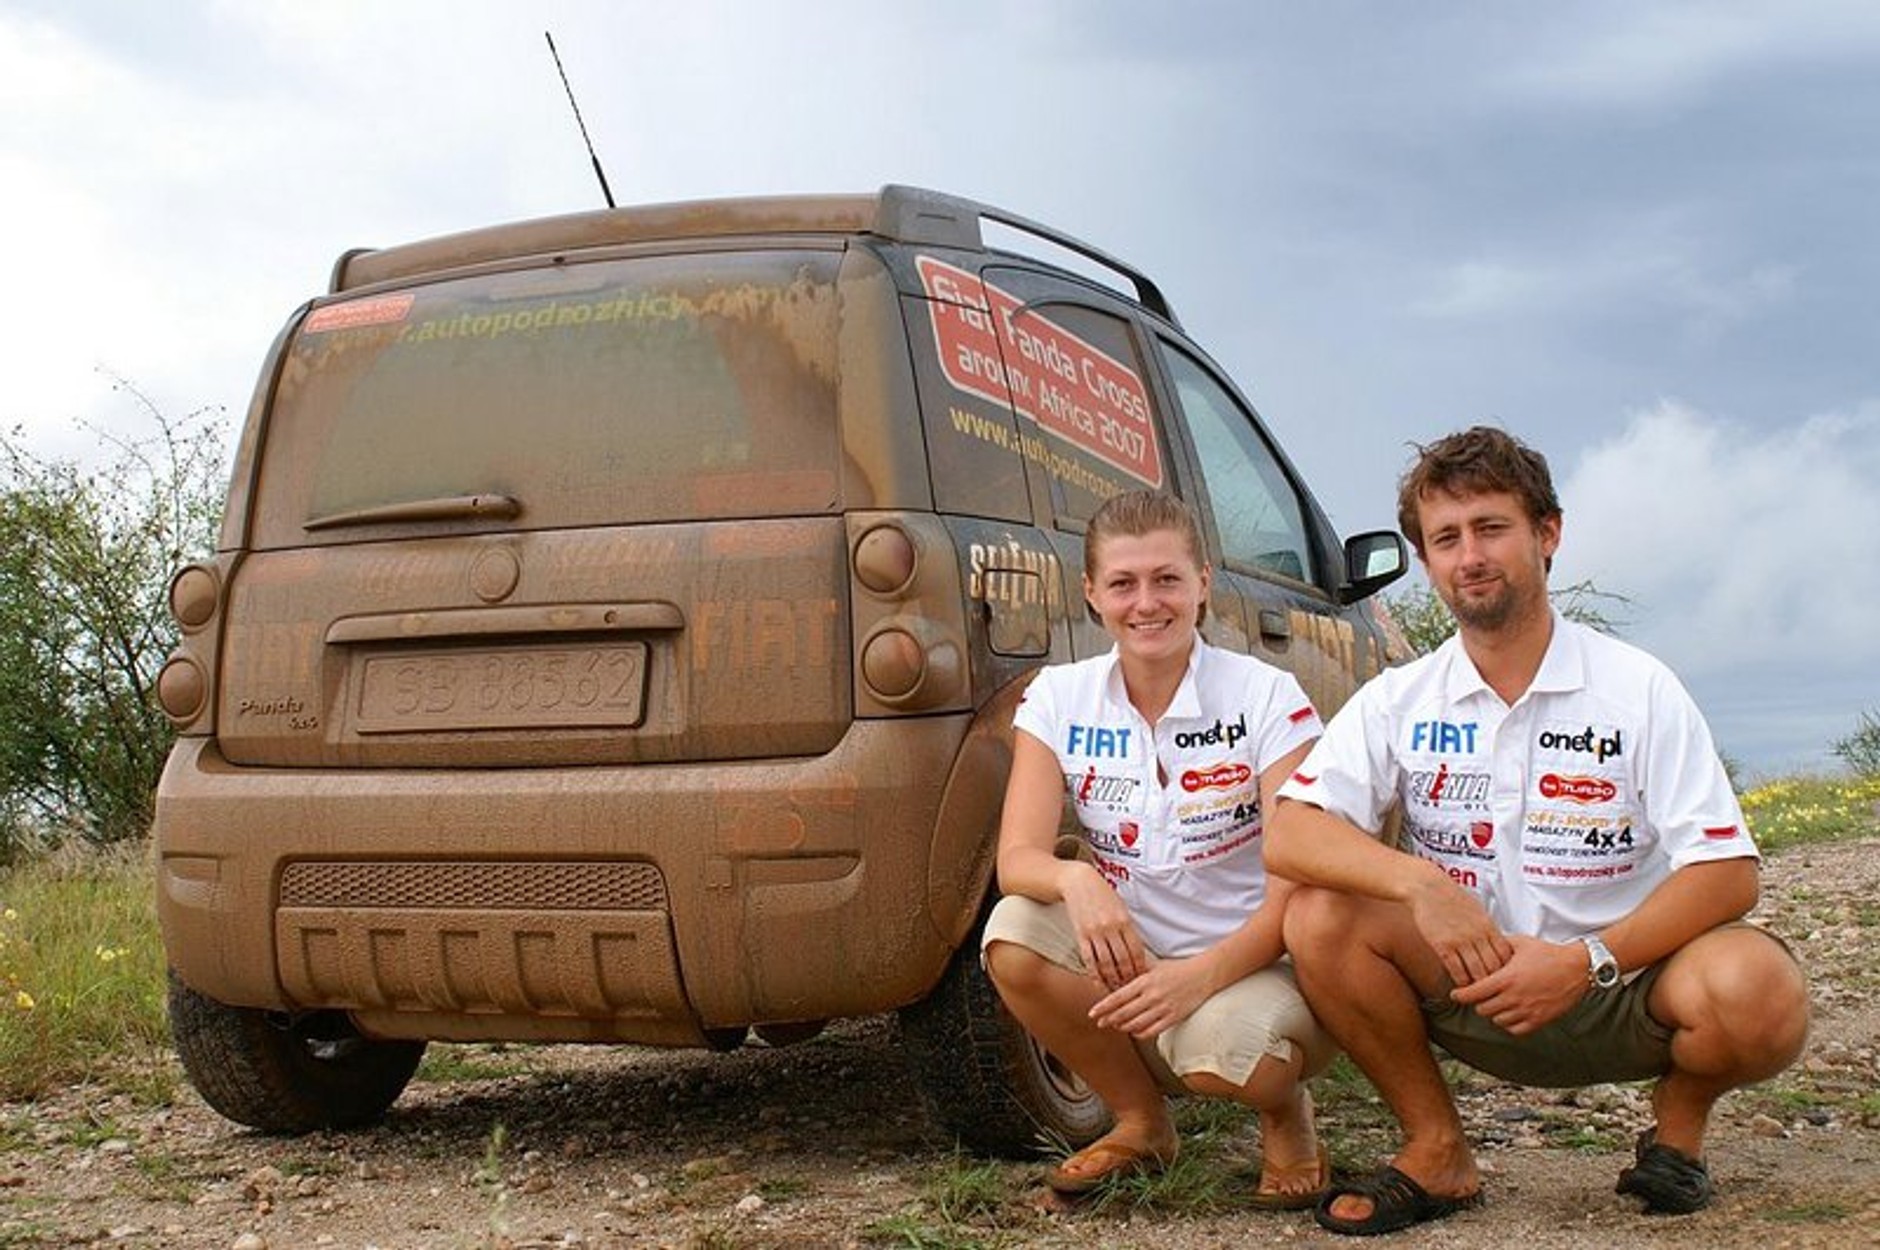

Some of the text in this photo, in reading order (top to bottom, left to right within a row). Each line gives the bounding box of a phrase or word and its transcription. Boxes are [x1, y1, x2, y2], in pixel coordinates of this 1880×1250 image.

[932, 274, 995, 337] Fiat
[1081, 357, 1147, 423] Cross
[1038, 378, 1096, 437] Africa
[1097, 407, 1146, 462] 2007
[1067, 725, 1131, 758] FIAT
[1175, 713, 1247, 749] onet.pl
[1411, 721, 1478, 753] FIAT
[1539, 726, 1621, 764] onet.pl
[1234, 801, 1259, 820] 4x
[1584, 826, 1635, 849] 4x4
